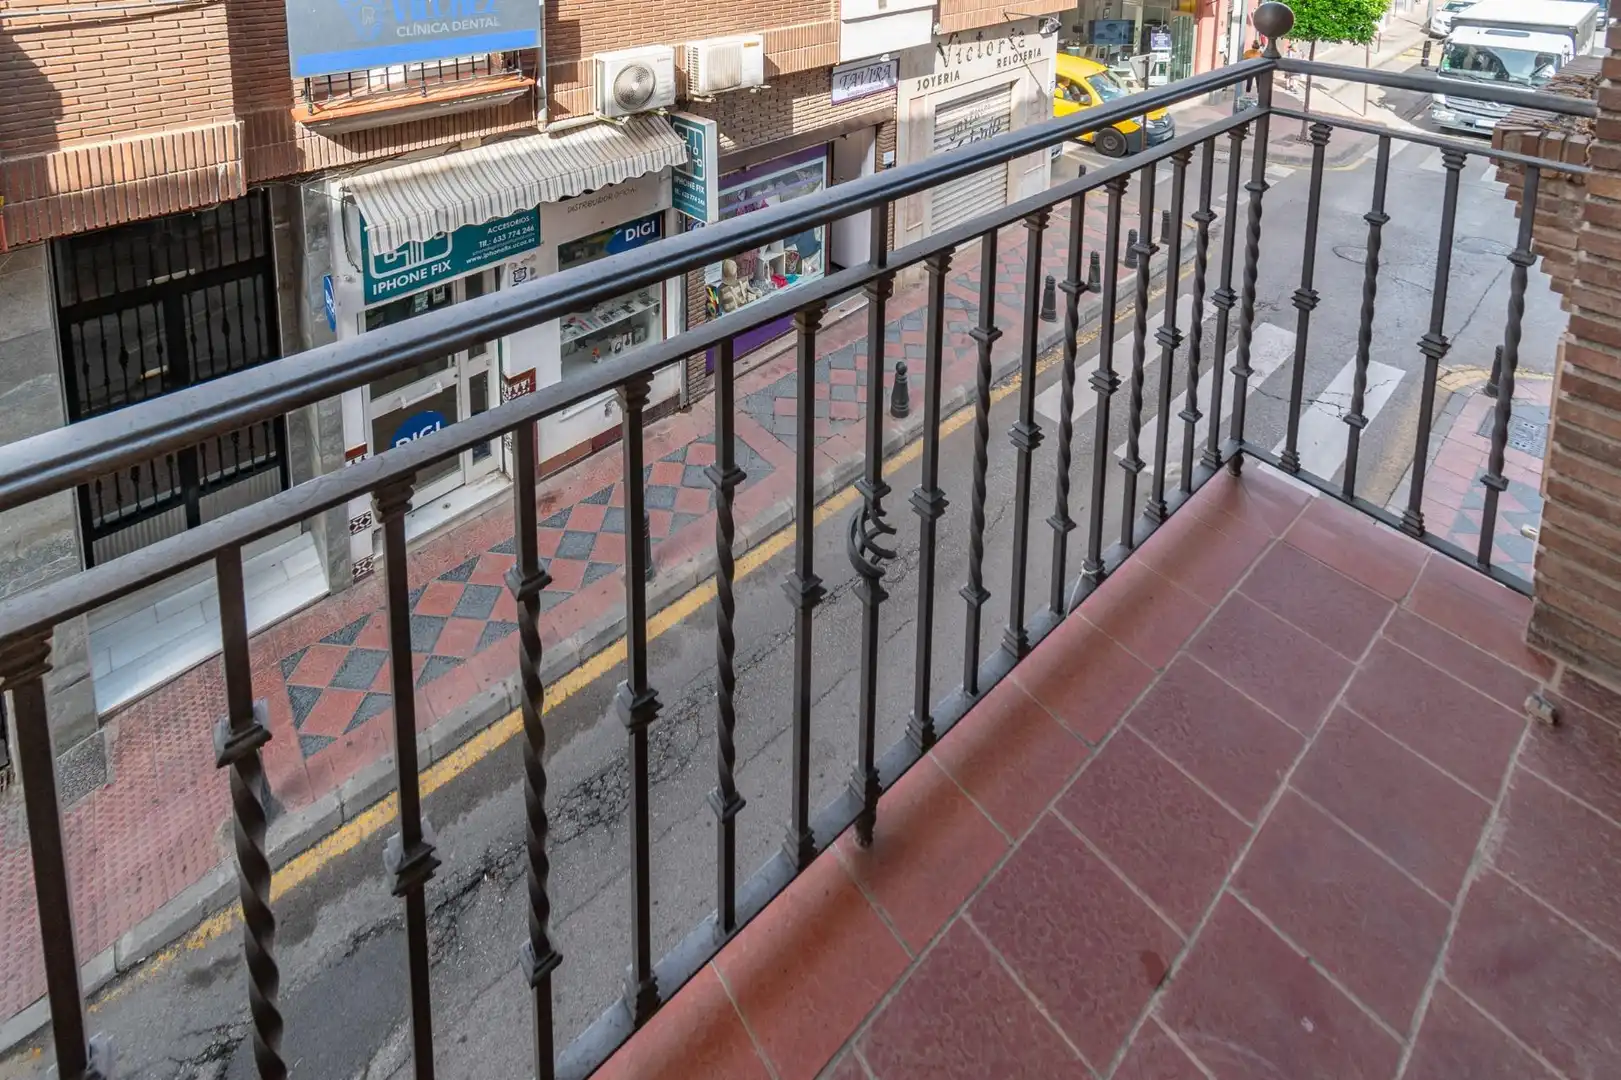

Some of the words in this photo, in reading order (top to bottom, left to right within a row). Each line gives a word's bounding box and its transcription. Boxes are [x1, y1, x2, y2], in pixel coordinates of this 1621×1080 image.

[396, 22, 449, 37] CLÍNICA
[452, 17, 501, 32] DENTAL
[916, 70, 961, 92] JOYERIA
[487, 215, 530, 234] ACCESORIOS
[493, 233, 507, 244] 633
[508, 229, 521, 239] 774
[521, 224, 535, 234] 246
[625, 220, 656, 242] DIGI
[372, 268, 428, 296] IPHONE
[431, 259, 452, 276] FIX
